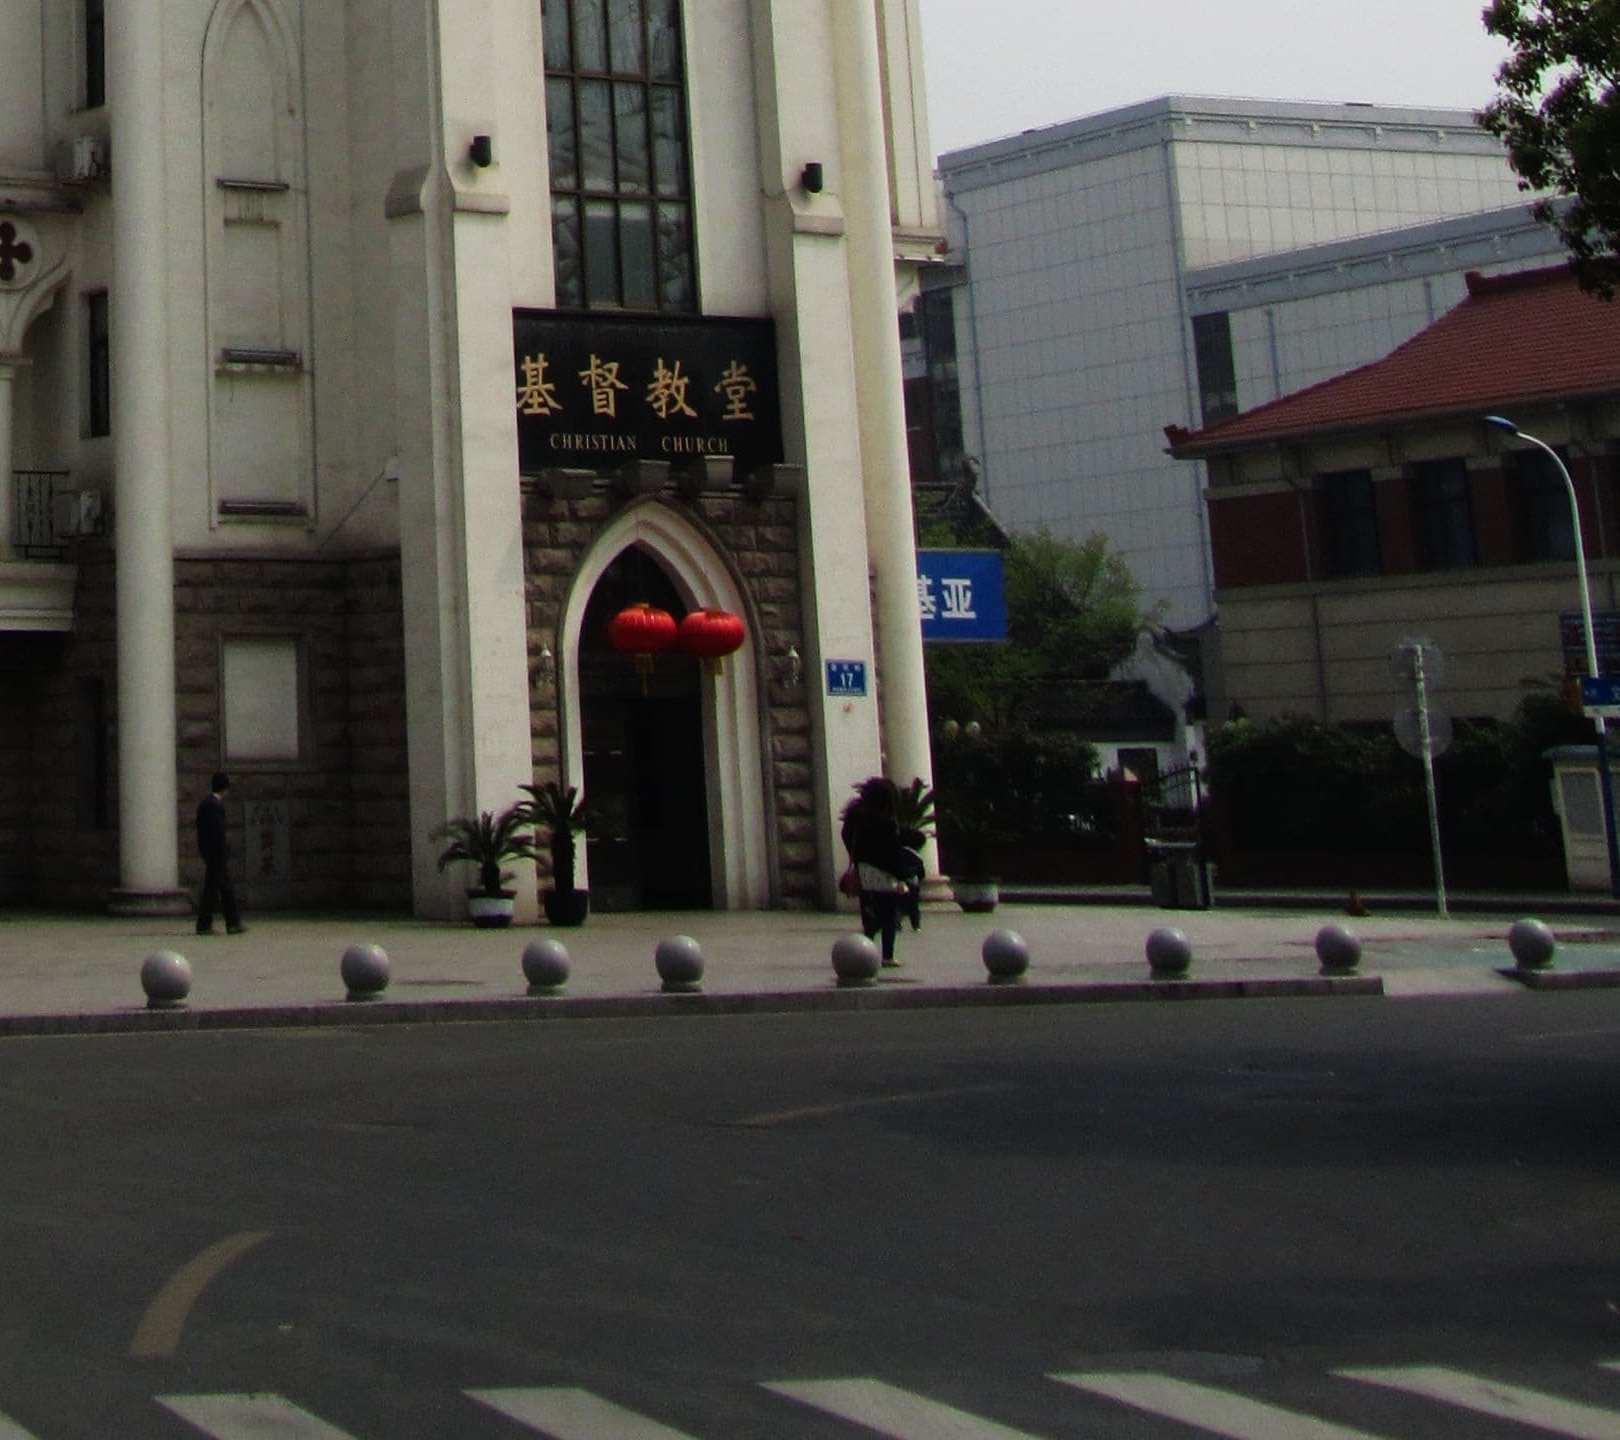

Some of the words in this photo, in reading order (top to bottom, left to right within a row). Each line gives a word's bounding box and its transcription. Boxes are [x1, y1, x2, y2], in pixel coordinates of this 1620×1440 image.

[517, 354, 756, 421] 基督教堂
[550, 433, 636, 450] CHRISTIAN
[662, 436, 728, 452] CHURCH
[840, 672, 854, 687] 17
